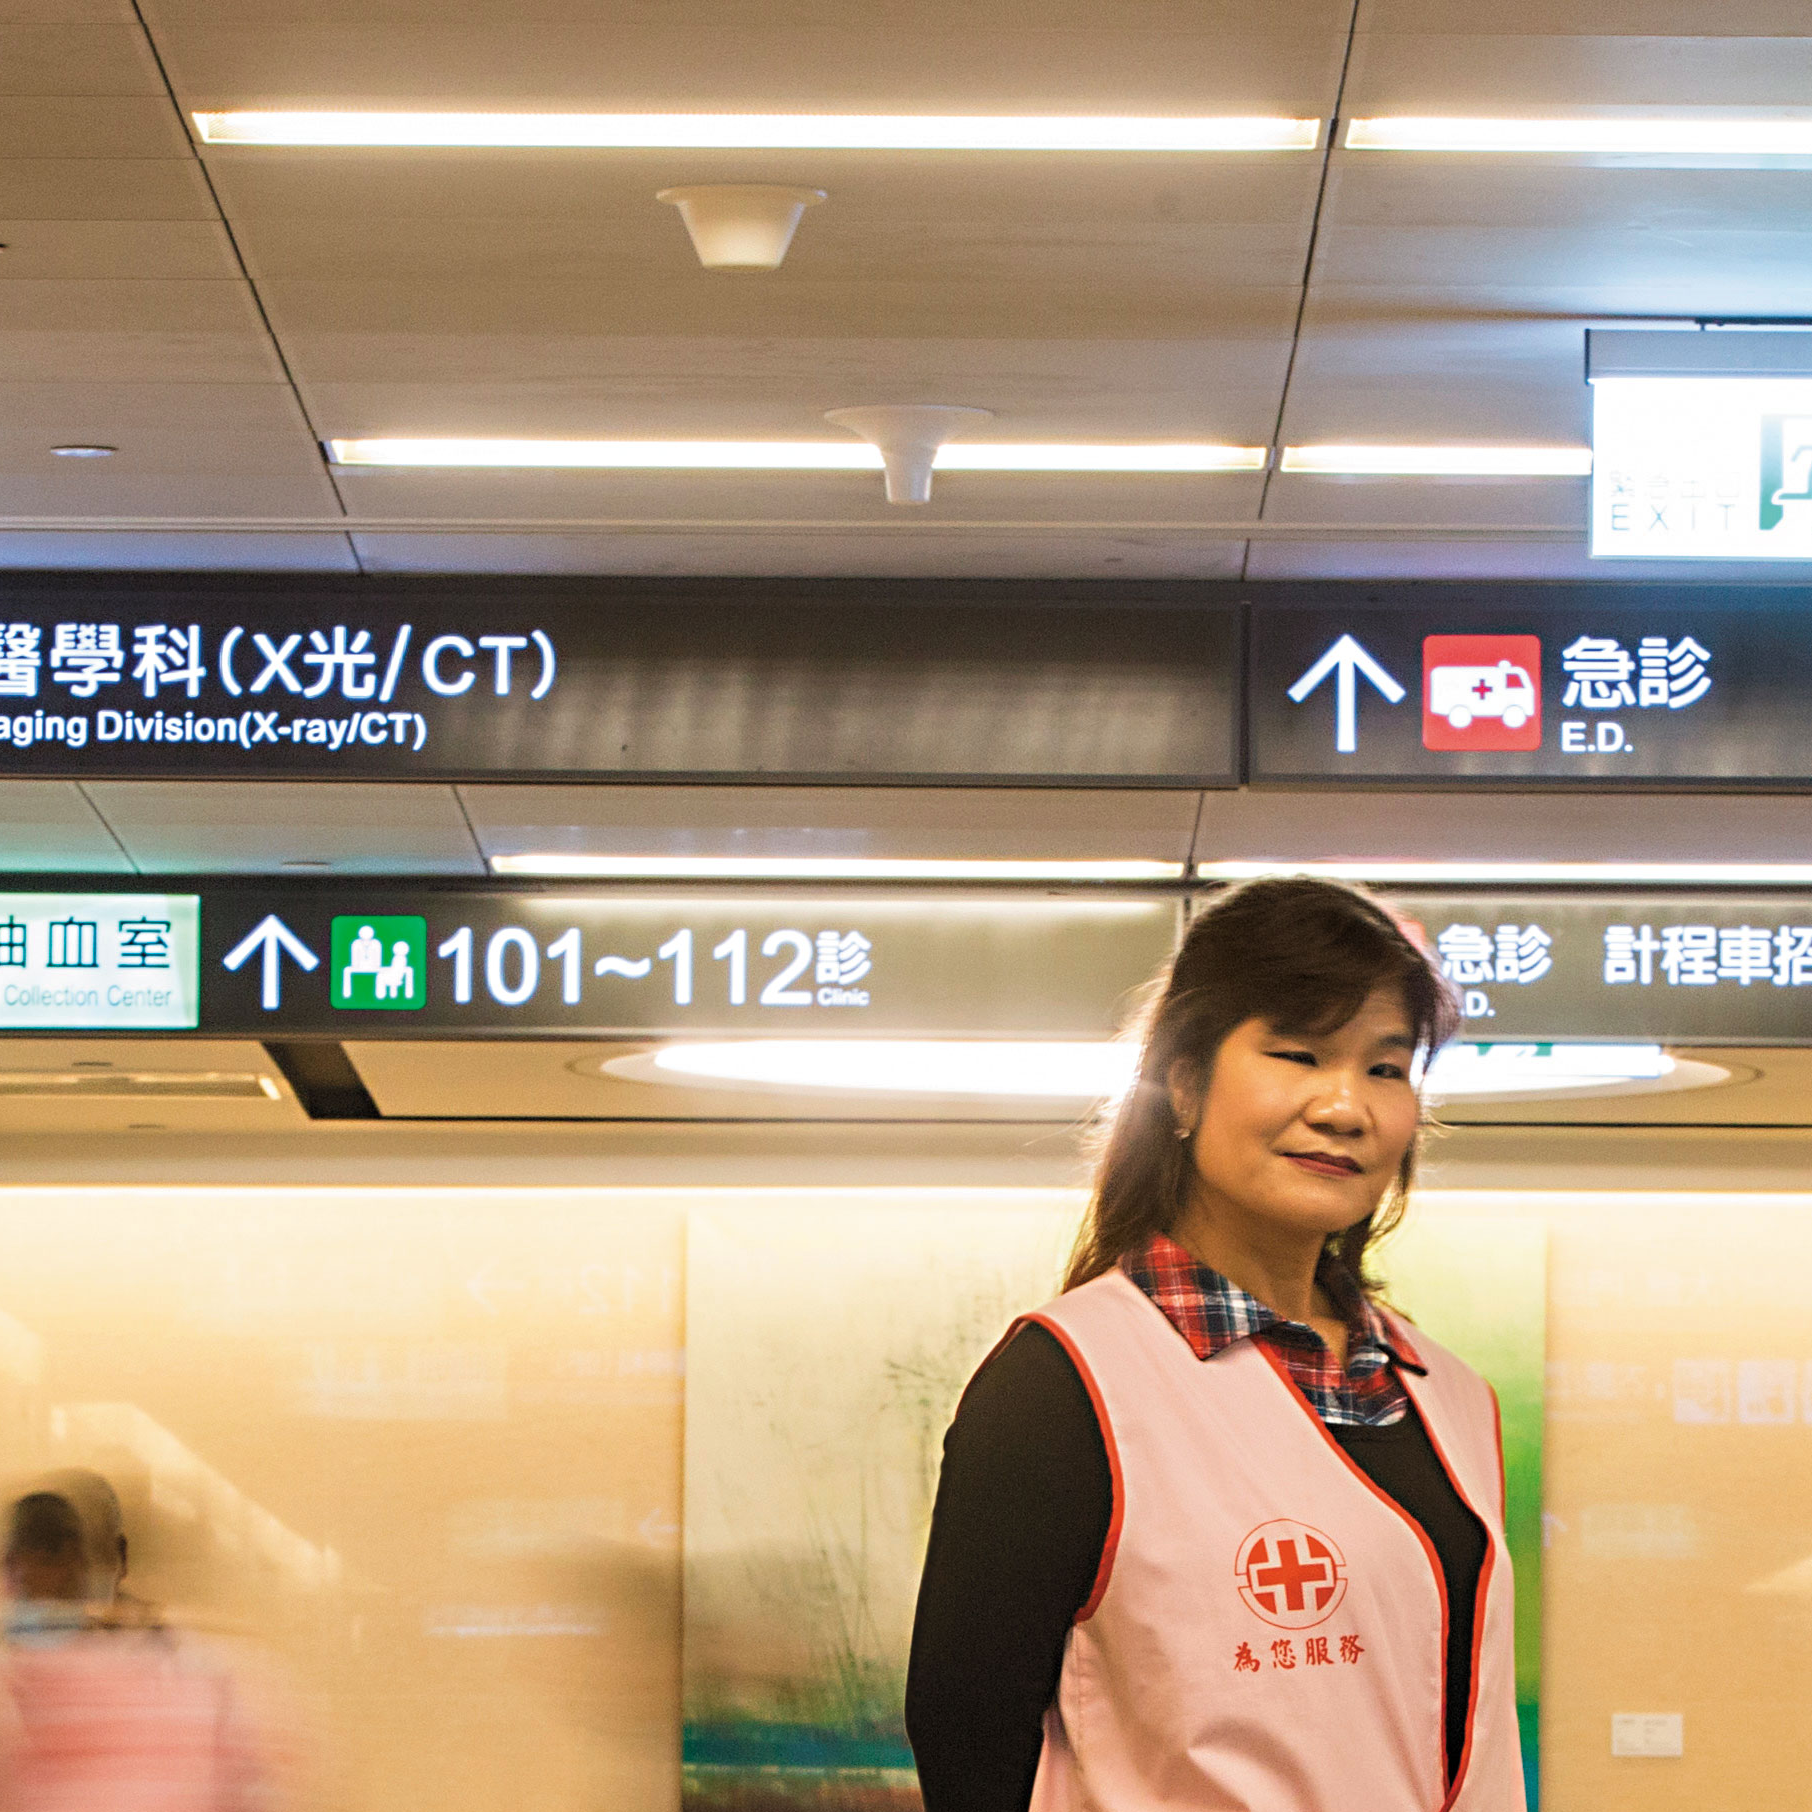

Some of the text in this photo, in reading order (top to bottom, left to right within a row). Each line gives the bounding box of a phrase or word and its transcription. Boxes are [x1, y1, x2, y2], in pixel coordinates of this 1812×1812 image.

[1610, 503, 1736, 532] EXIT
[1561, 636, 1712, 709] 急診
[97, 710, 426, 751] Division(X-ray/CT)
[1561, 721, 1634, 753] E.D.
[1438, 924, 1553, 984] 急診
[4, 983, 98, 1007] Collection
[107, 984, 172, 1007] Center
[817, 986, 870, 1006] Clinic
[1459, 990, 1496, 1018] .D.
[1233, 1634, 1366, 1673] 為您服務
